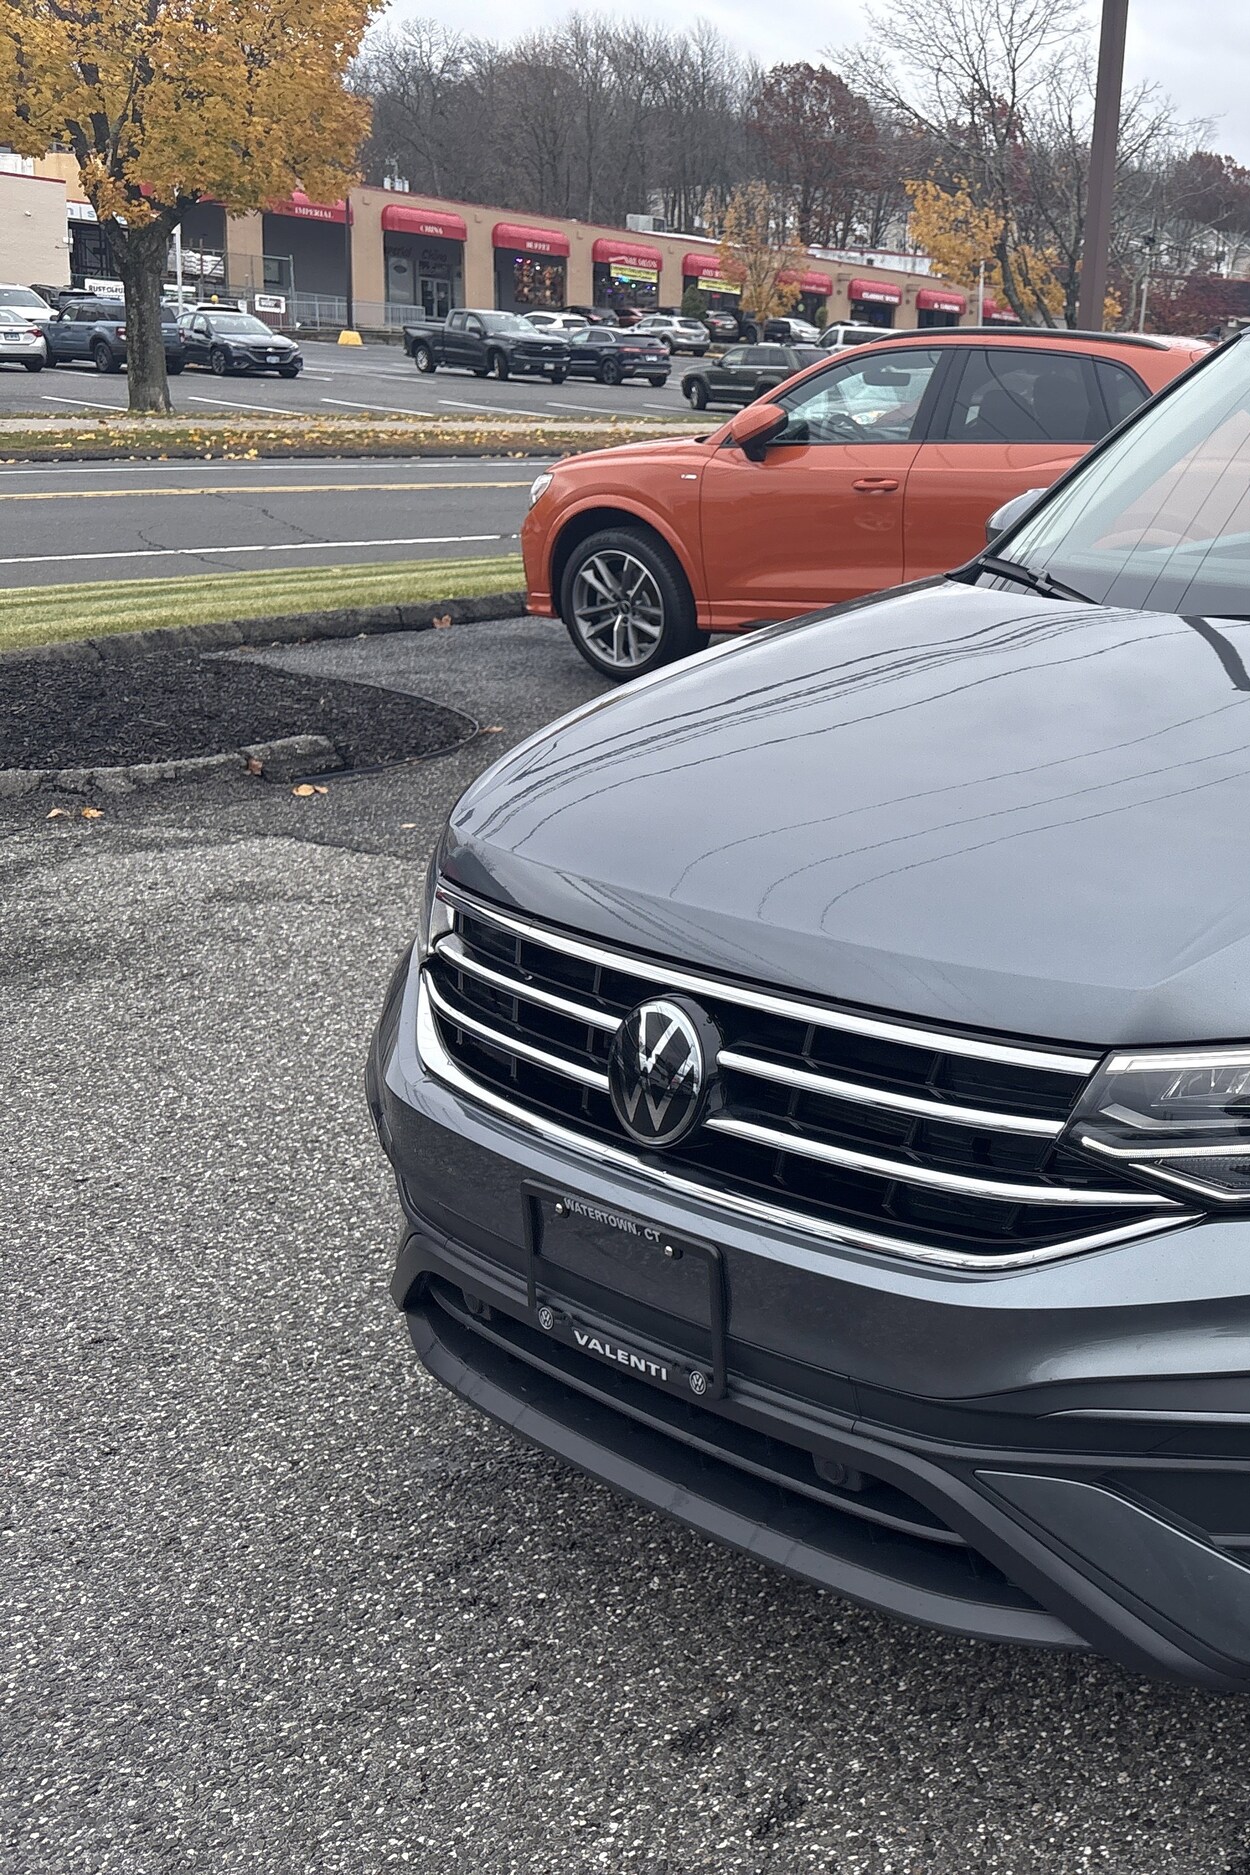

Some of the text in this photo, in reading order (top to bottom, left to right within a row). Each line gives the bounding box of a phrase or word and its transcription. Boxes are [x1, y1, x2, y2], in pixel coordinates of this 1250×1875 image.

[563, 1197, 661, 1243] WATERTOWN, CT
[573, 1329, 669, 1382] VALENTI
